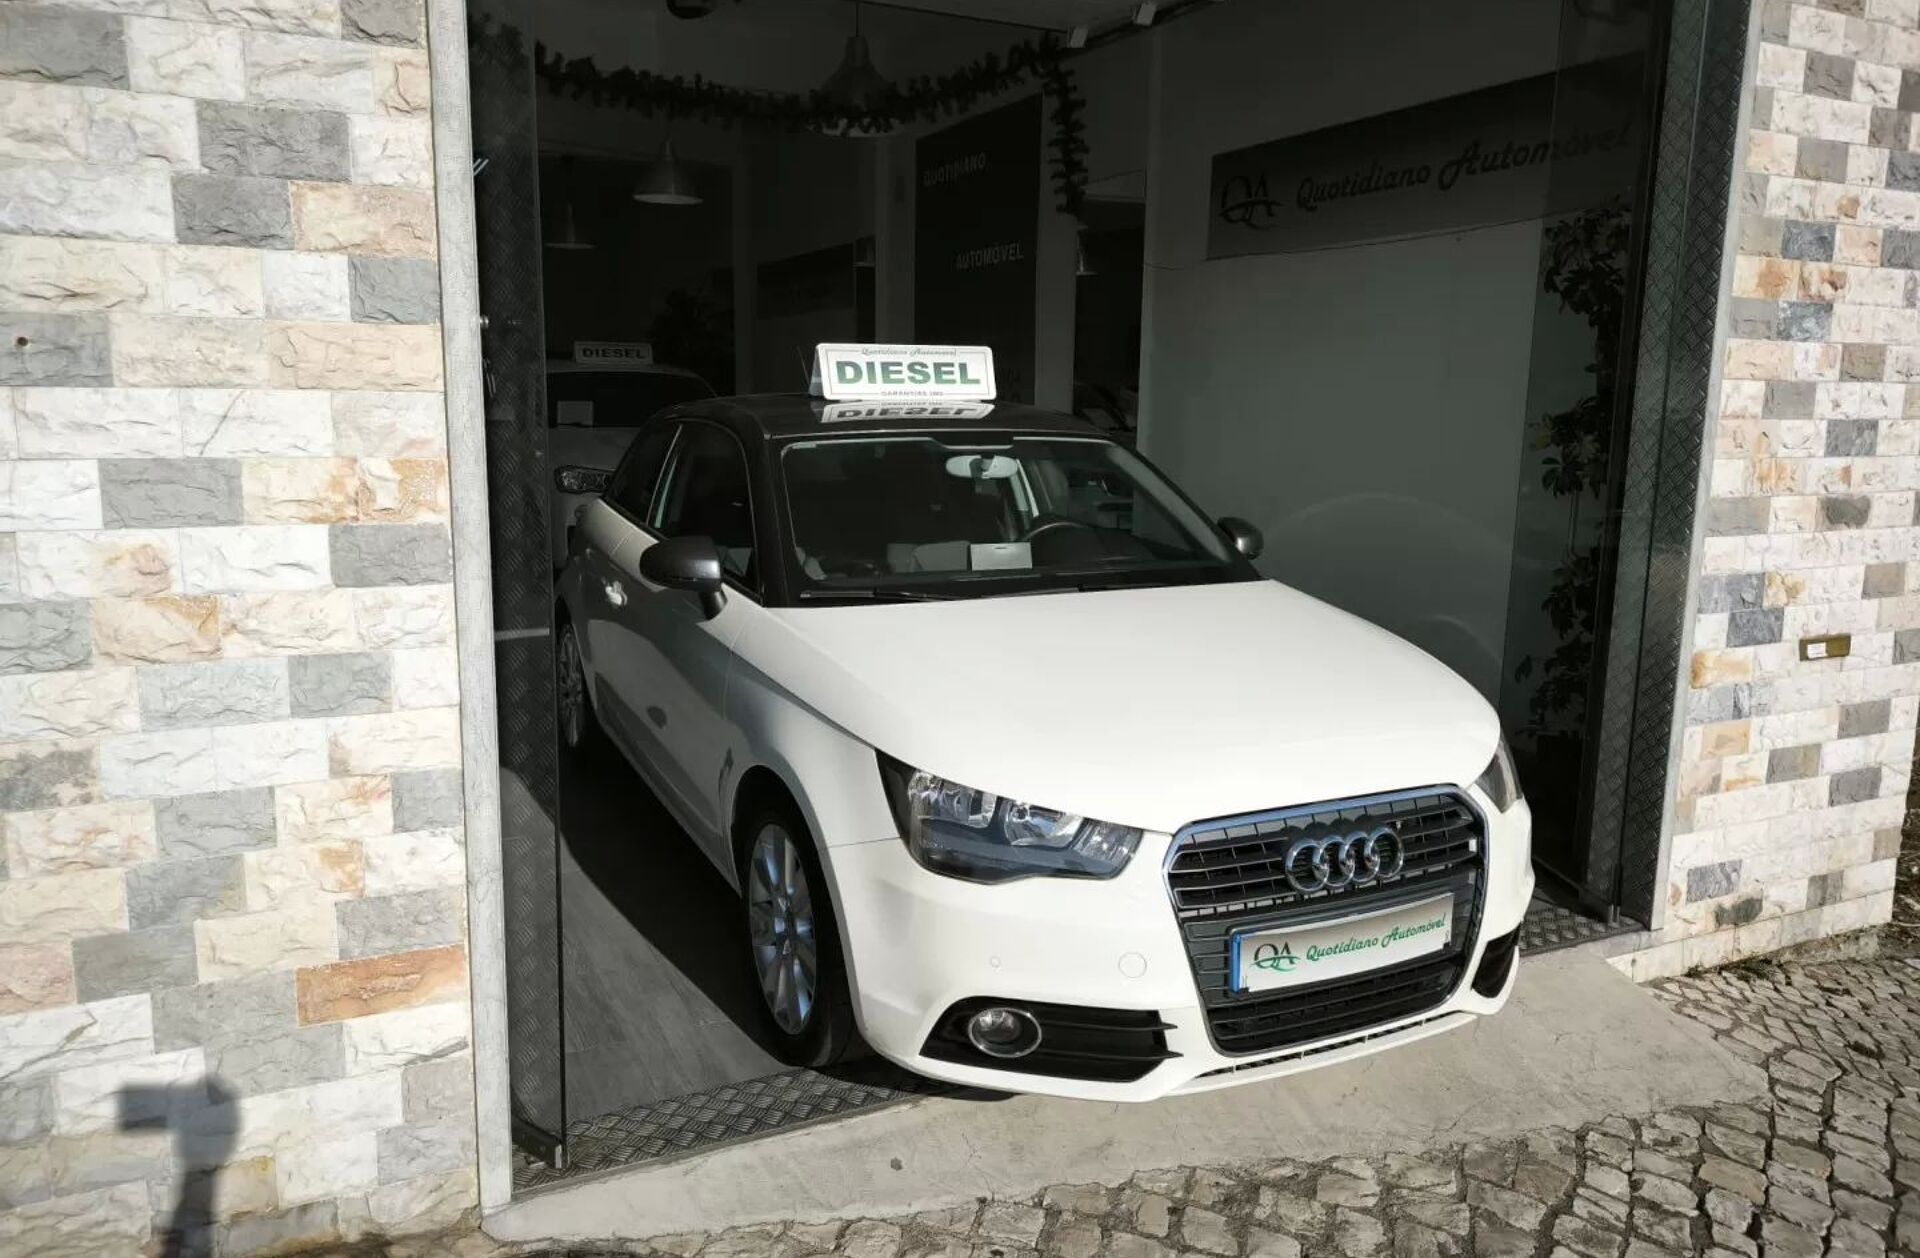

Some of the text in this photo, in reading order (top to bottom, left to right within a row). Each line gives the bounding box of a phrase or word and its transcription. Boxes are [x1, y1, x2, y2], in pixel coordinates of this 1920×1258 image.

[1297, 161, 1430, 212] Quotidiano
[582, 347, 646, 359] DIESEL
[835, 360, 981, 385] DIESEL
[1306, 936, 1378, 962] Quotidiano
[1381, 912, 1447, 948] Automóvel
